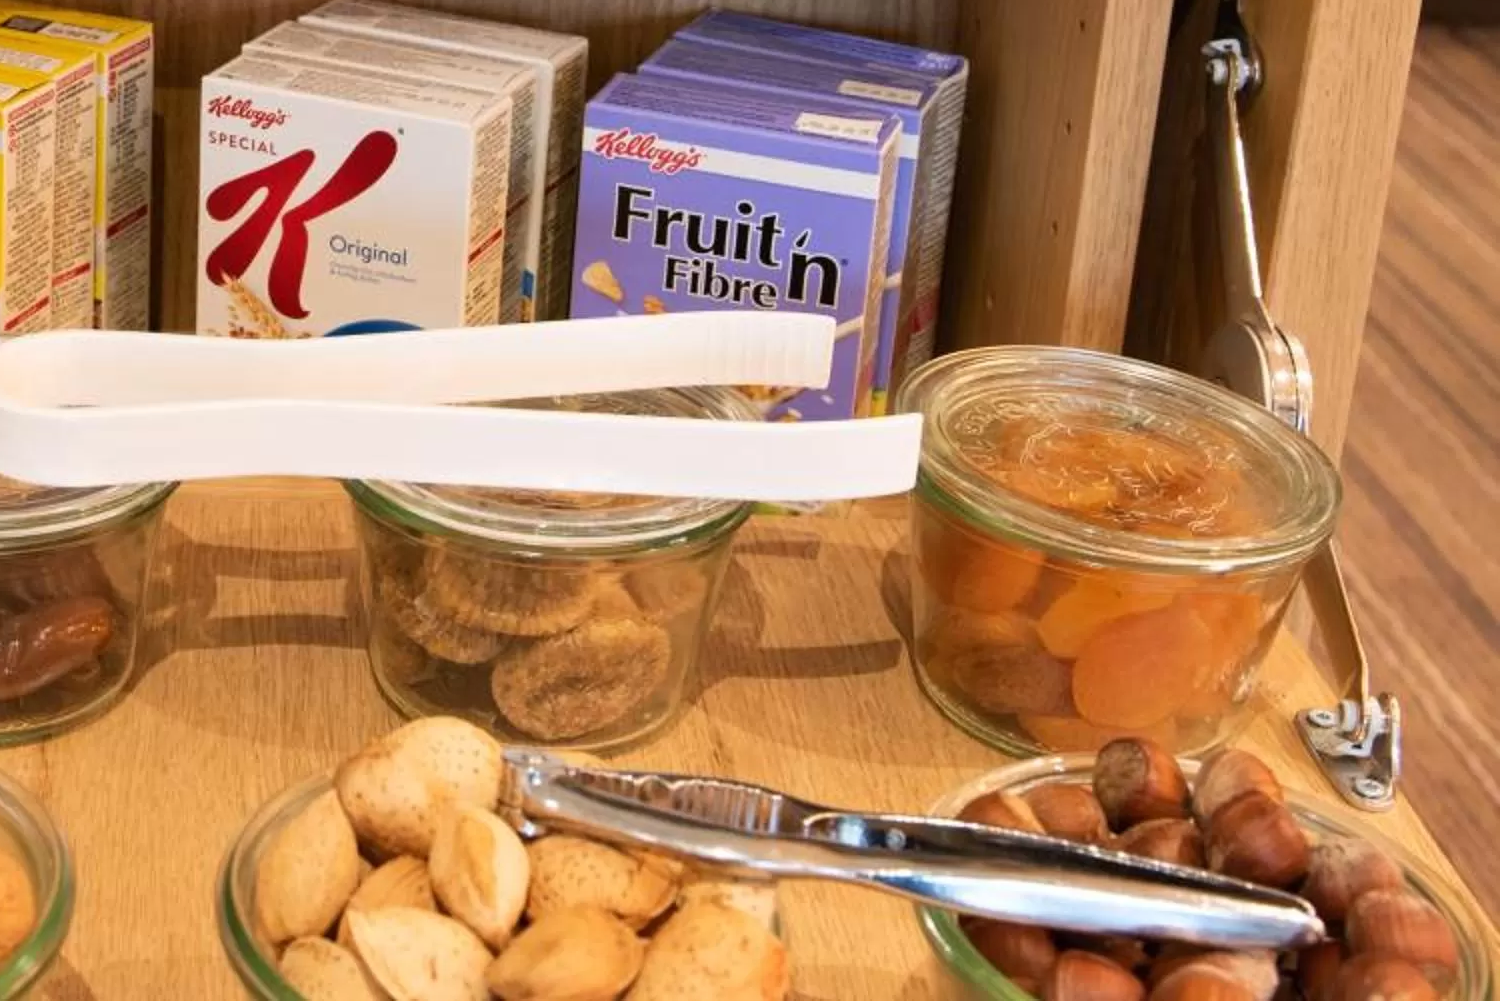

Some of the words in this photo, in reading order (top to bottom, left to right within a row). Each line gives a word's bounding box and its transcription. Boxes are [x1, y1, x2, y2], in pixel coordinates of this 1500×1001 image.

[208, 95, 287, 129] Kellogg's
[208, 130, 278, 156] SPECIAL
[596, 131, 702, 172] Kellogg's
[206, 130, 398, 319] K
[329, 234, 408, 267] Original
[665, 257, 777, 308] Fibre
